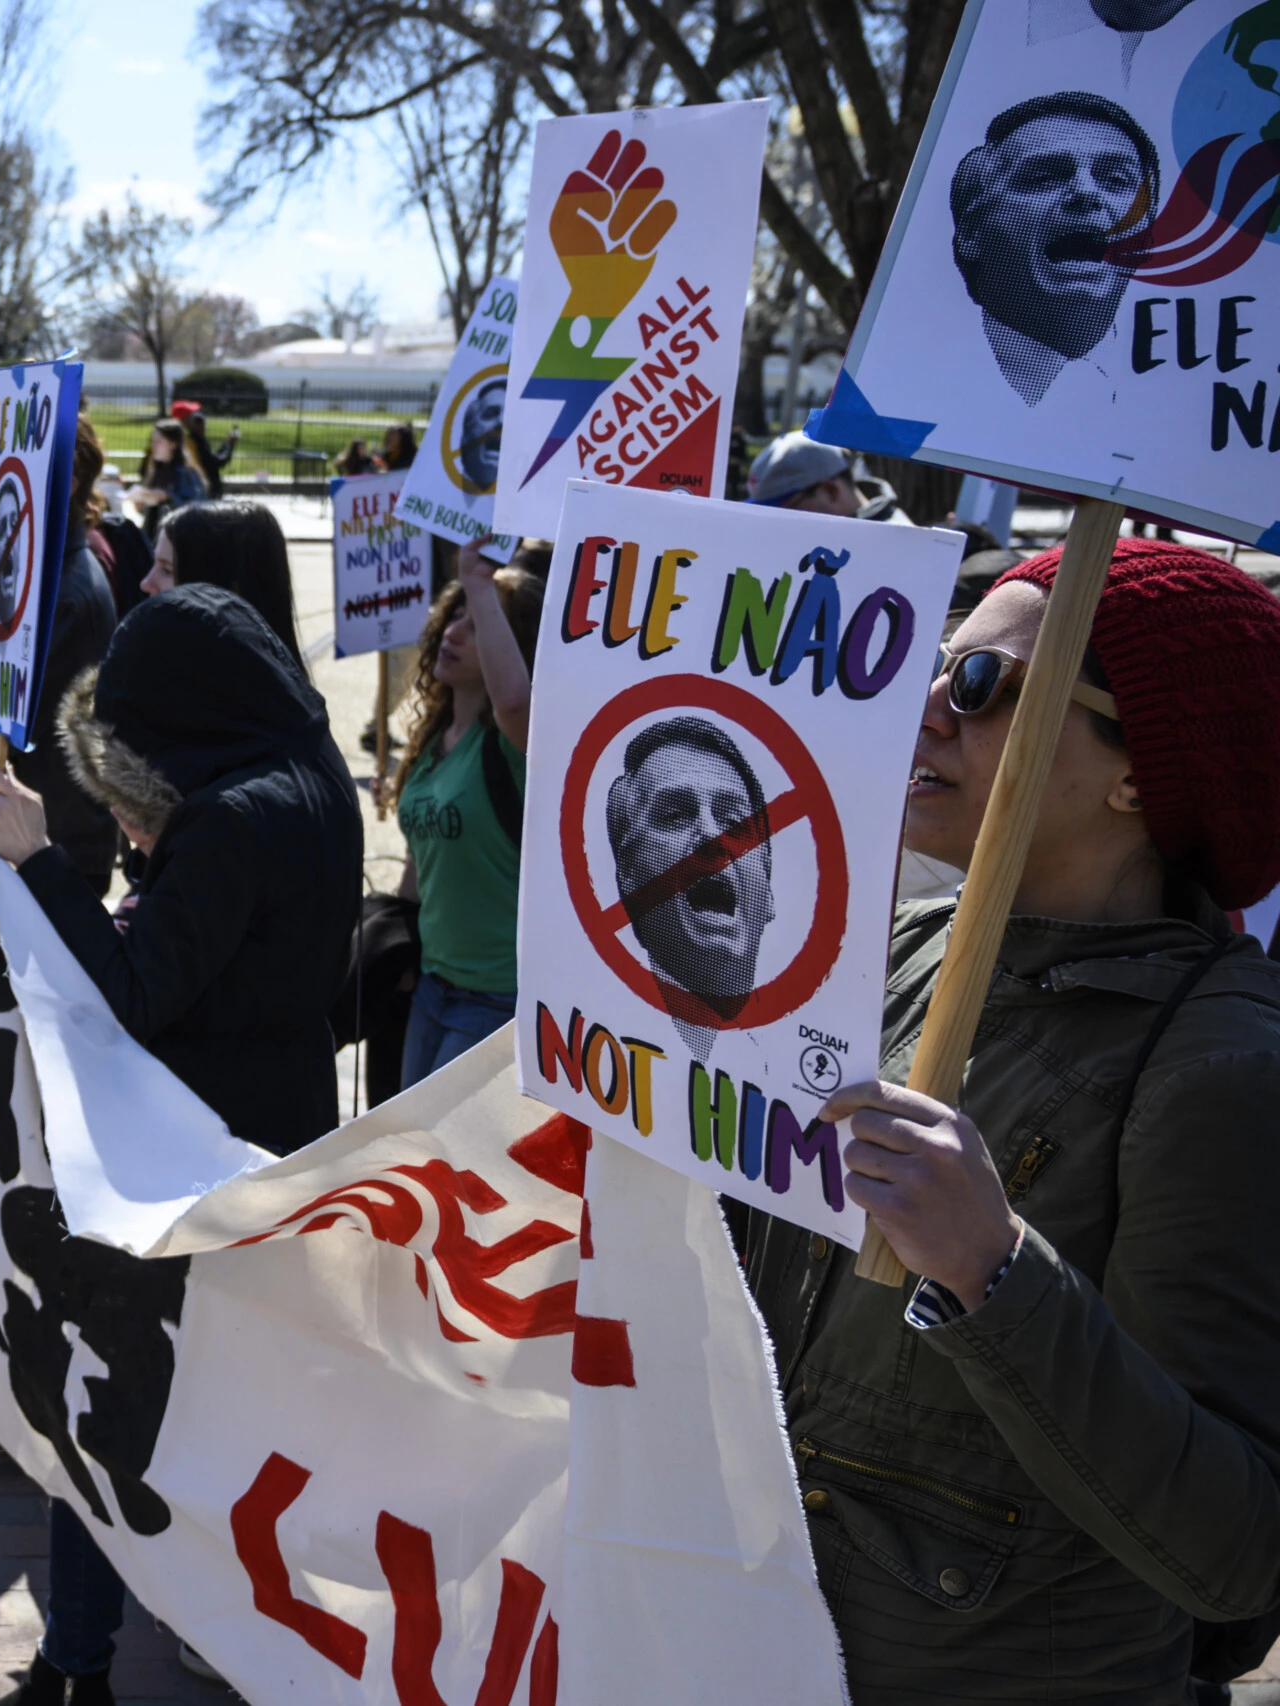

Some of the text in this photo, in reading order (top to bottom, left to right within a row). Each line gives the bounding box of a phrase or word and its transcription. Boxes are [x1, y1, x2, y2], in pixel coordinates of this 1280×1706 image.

[467, 327, 508, 356] WITH
[637, 276, 710, 351] ALL
[1131, 296, 1256, 374] ELE
[11, 381, 51, 454] NÃO
[576, 305, 720, 470] AGAINST
[582, 373, 714, 485] SCISM
[352, 492, 382, 519] ELE
[346, 545, 382, 570] NON
[400, 556, 421, 578] NO
[345, 592, 381, 620] NOT
[561, 535, 916, 700] ELE NÃO
[0, 661, 27, 722] HIM
[799, 1024, 849, 1054] DCUAH
[536, 1000, 845, 1213] NOT HIM
